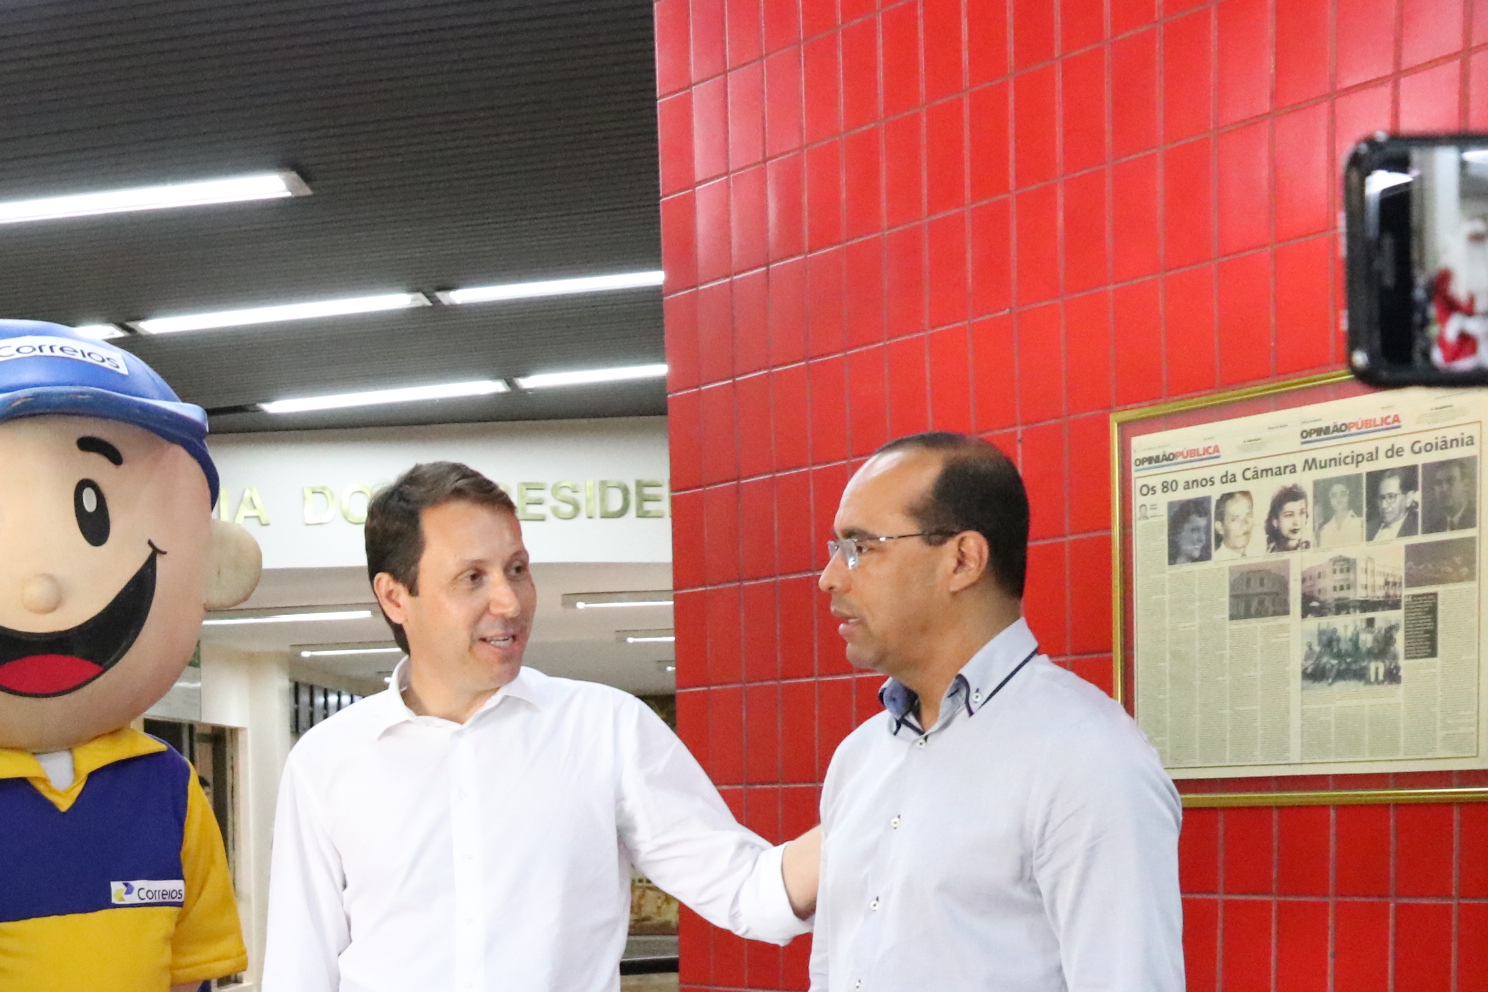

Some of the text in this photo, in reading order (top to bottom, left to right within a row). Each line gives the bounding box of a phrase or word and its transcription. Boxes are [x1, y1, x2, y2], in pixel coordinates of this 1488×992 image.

[1139, 432, 1476, 497] Os 80 anos da Câmara Municipal de Goiânia
[303, 484, 372, 526] DO
[137, 887, 183, 901] Correios
